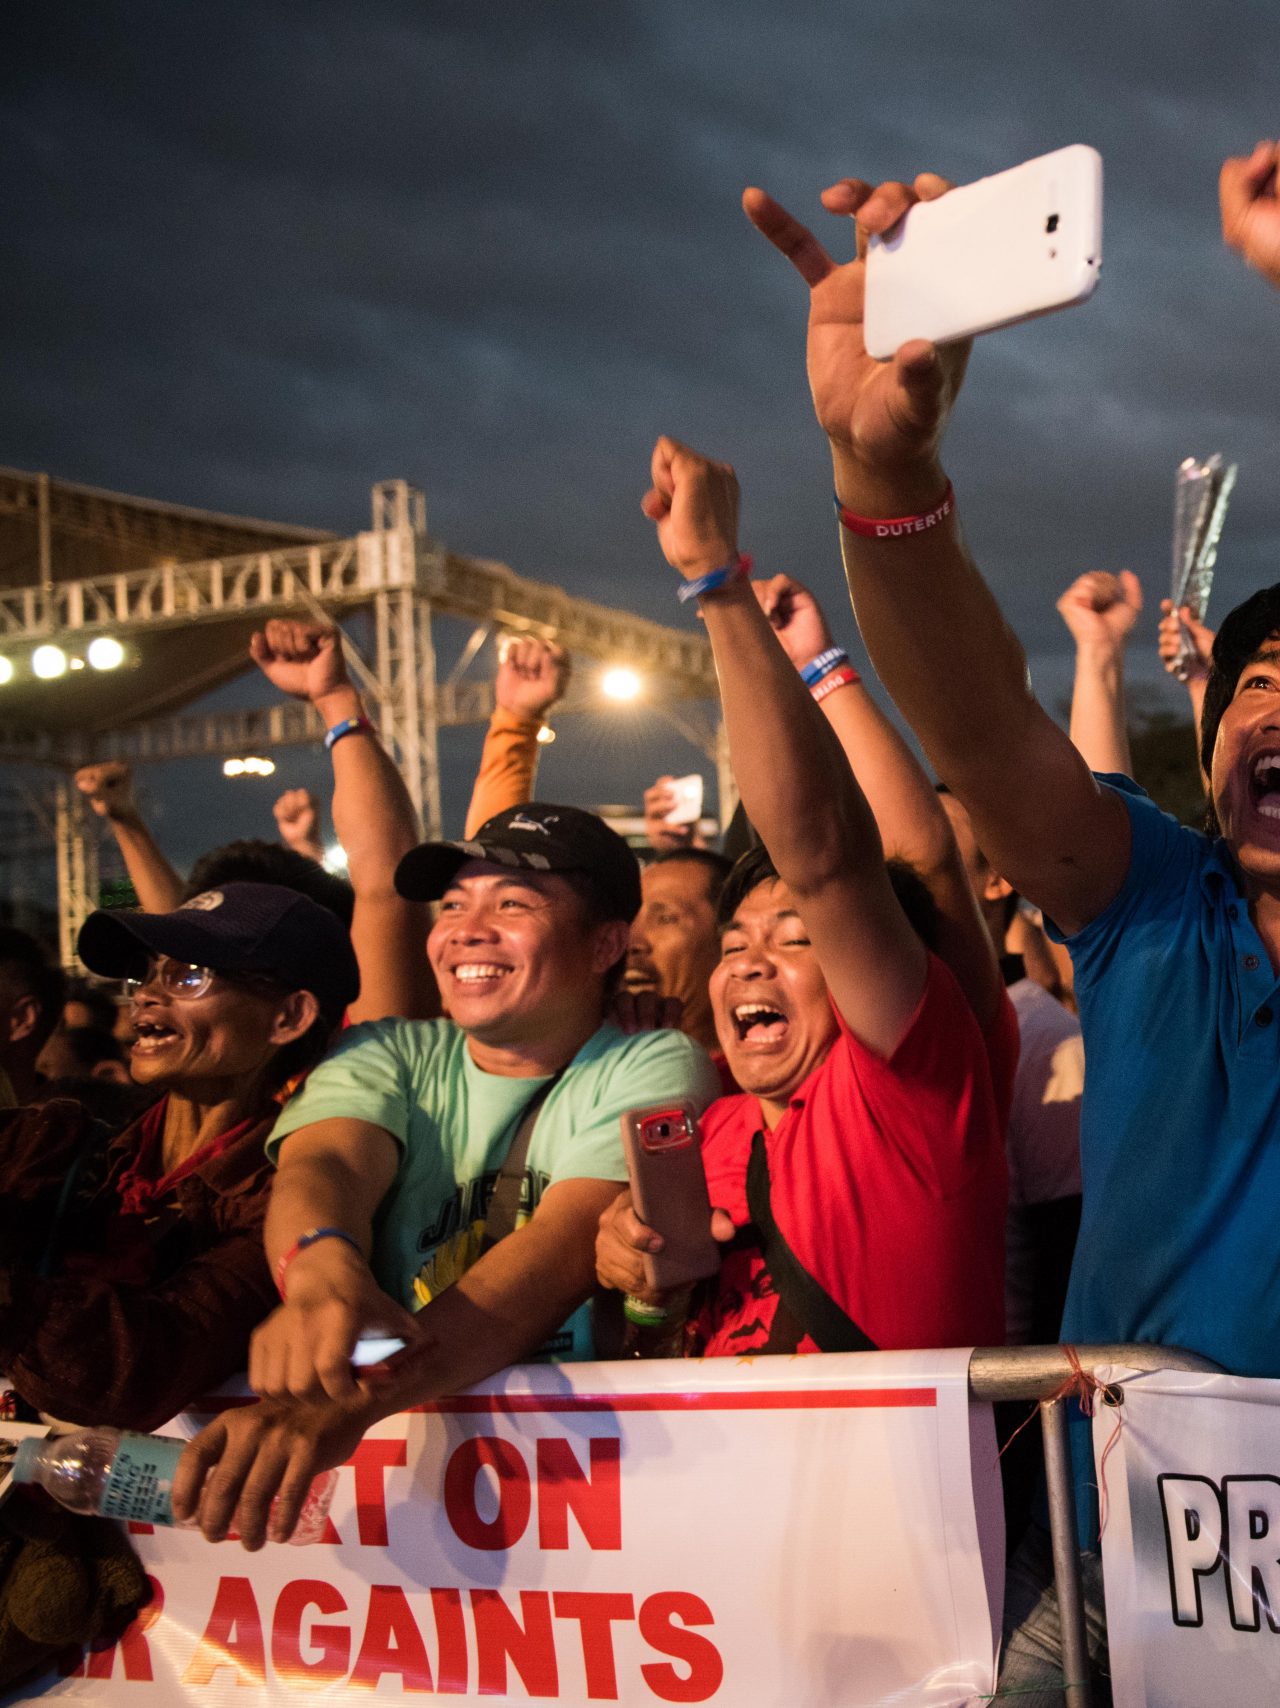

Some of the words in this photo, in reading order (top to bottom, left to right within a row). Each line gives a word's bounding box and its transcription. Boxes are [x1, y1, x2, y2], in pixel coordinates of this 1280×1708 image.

[875, 501, 951, 537] DUTERTE
[443, 1437, 623, 1551] ON
[182, 1575, 724, 1703] AGAINTS
